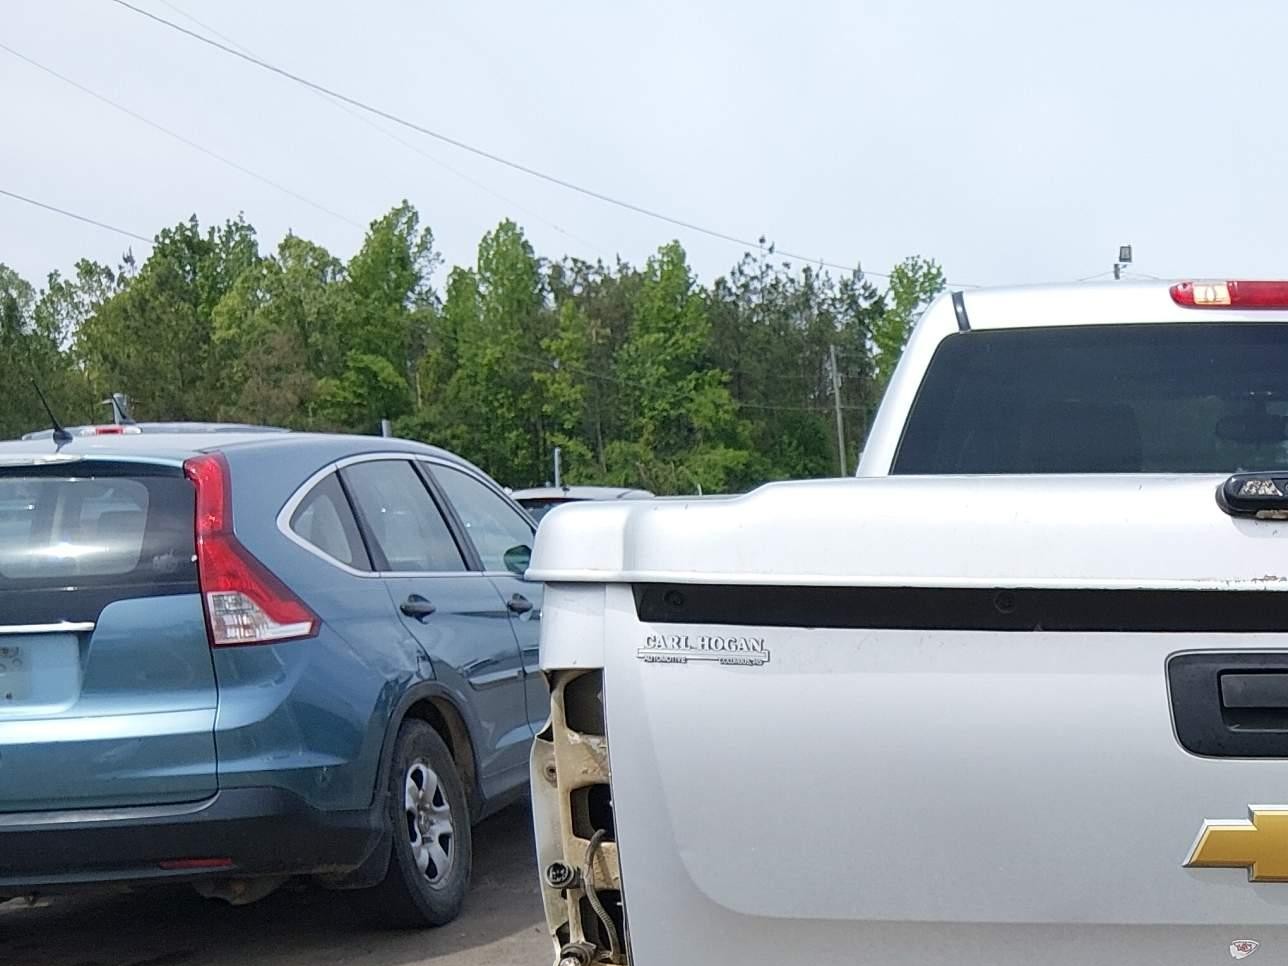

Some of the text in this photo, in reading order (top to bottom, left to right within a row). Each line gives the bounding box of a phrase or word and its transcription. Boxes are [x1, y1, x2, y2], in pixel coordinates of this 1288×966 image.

[646, 635, 765, 652] CARL HOGAN
[644, 655, 688, 663] AUTOMOTIVE
